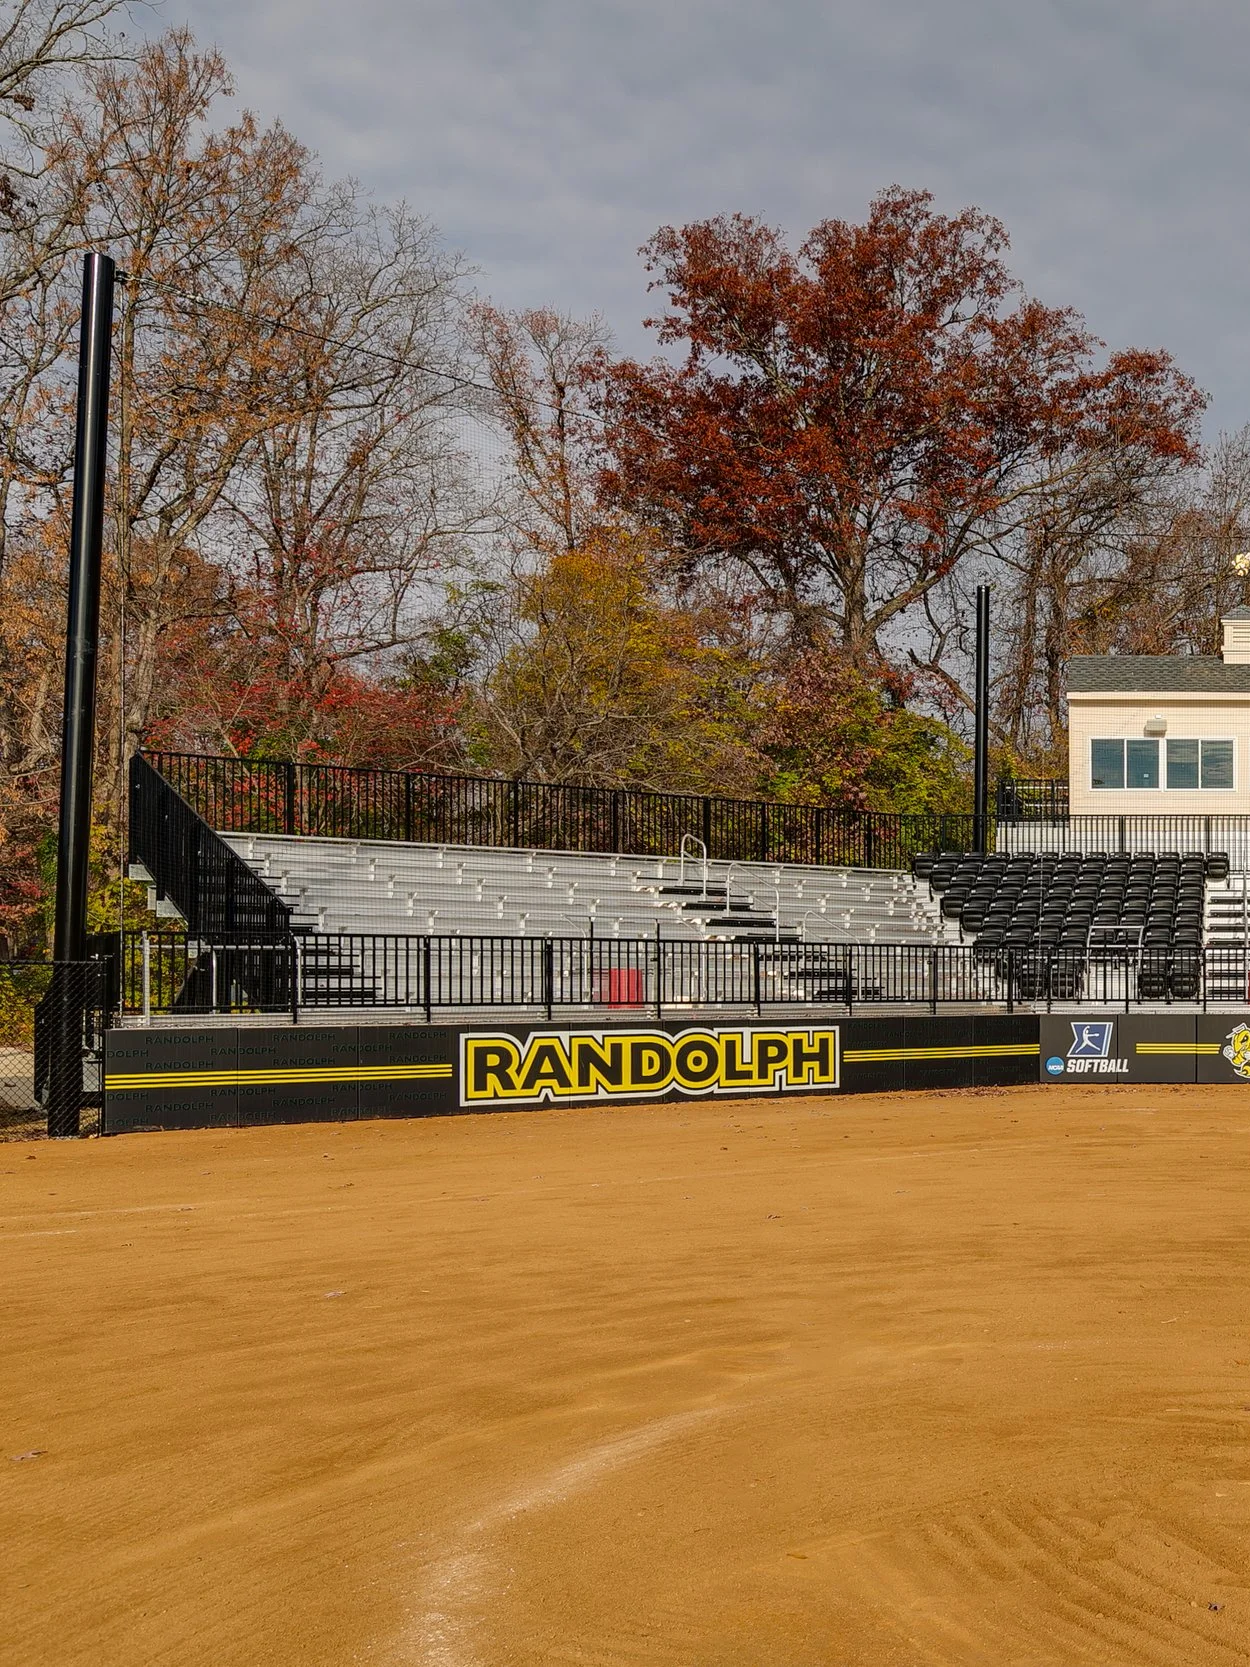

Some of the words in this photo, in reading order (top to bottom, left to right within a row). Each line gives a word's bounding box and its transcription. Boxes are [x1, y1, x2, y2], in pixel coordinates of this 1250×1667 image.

[273, 1033, 336, 1042] RANDOLPH
[389, 1031, 447, 1040] RANDOLPH
[145, 1036, 214, 1045] RANDOLPH
[210, 1047, 276, 1056] RANDOLPH
[332, 1044, 392, 1053] RANDOLPH
[273, 1057, 336, 1066] RANDOLPH
[389, 1054, 447, 1064] RANDOLPH
[145, 1061, 214, 1070] RANDOLPH
[467, 1032, 834, 1098] RANDOLPH
[1066, 1059, 1129, 1073] SOFTBALL
[332, 1083, 392, 1092] RANDOLPH
[210, 1088, 276, 1097] RANDOLPH
[389, 1092, 447, 1101] RANDOLPH
[272, 1097, 335, 1106] RANDOLPH
[145, 1102, 214, 1113] RANDOLPH
